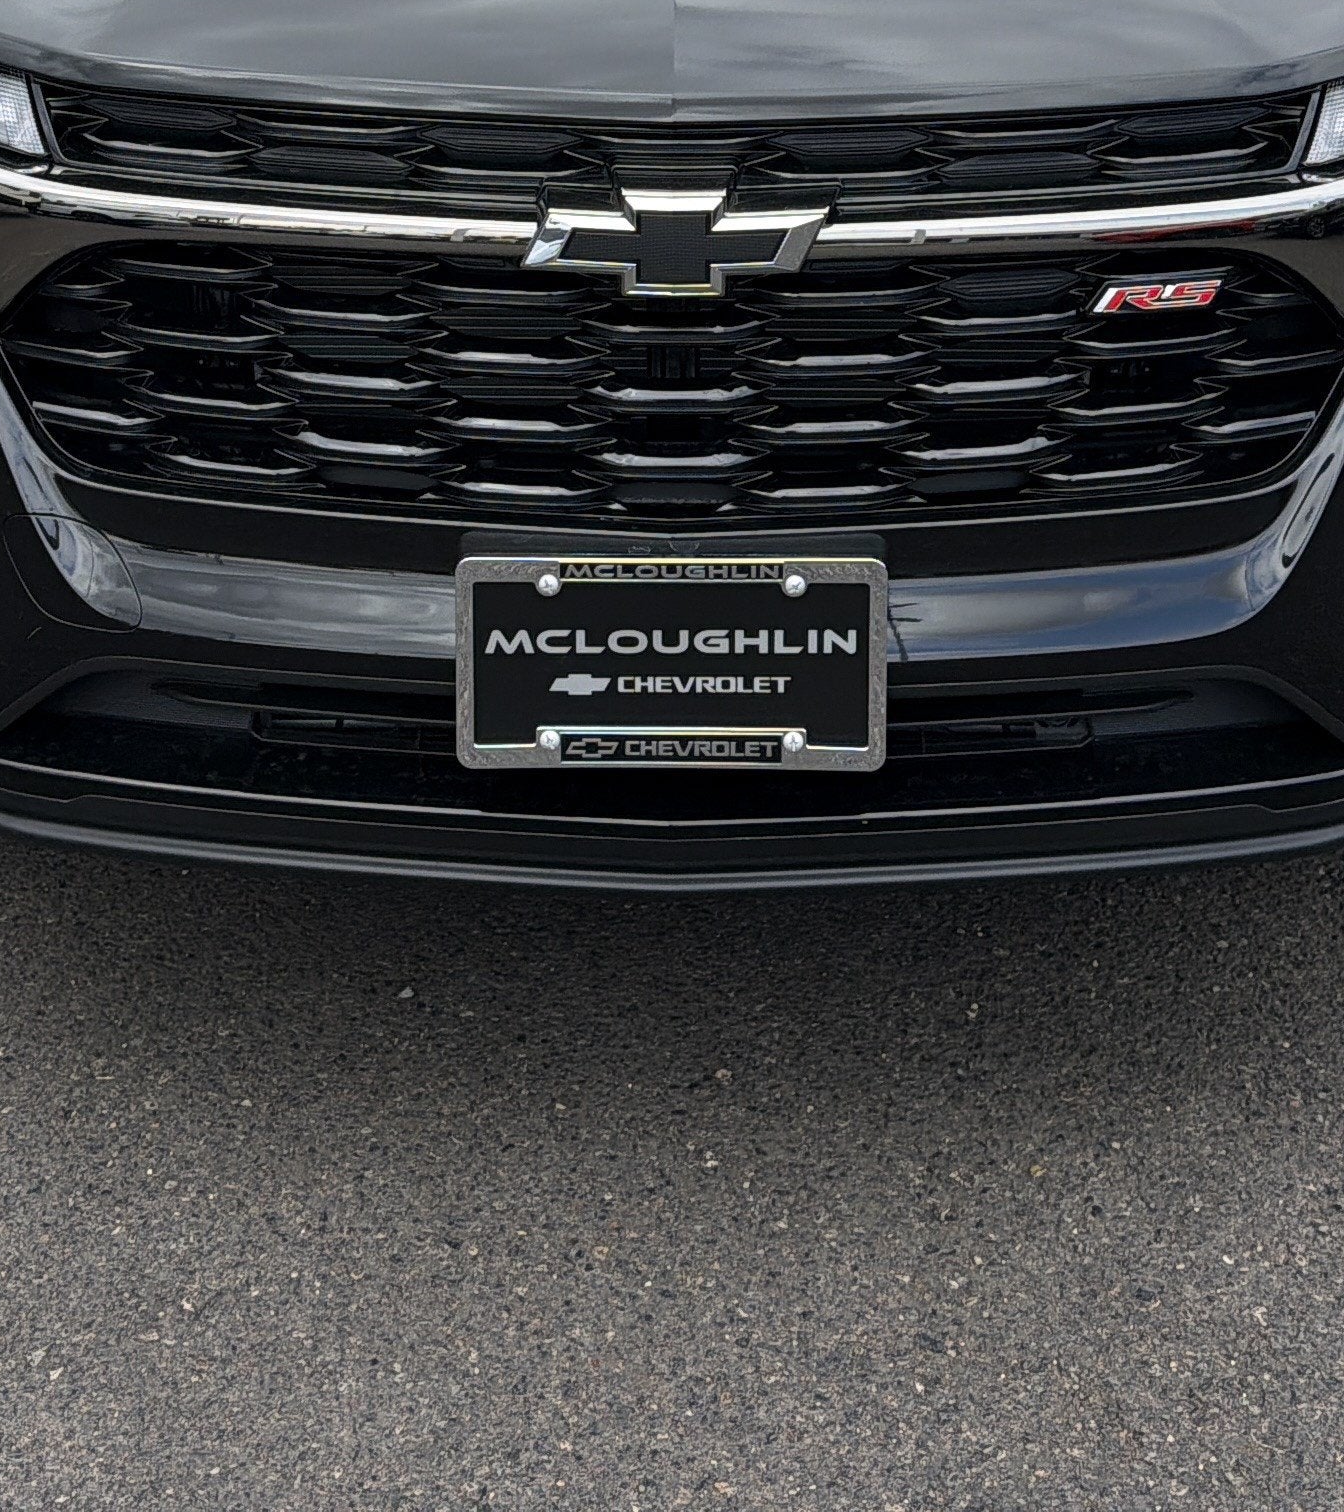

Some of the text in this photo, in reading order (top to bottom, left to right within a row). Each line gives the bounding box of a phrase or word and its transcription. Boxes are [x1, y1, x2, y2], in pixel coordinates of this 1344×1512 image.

[1092, 279, 1223, 313] RS
[564, 564, 780, 580] MCLOUGHLIN
[484, 629, 857, 655] MCLOUGHLIN
[617, 676, 792, 694] CHEVROLET
[624, 740, 779, 758] CHEVROLET
